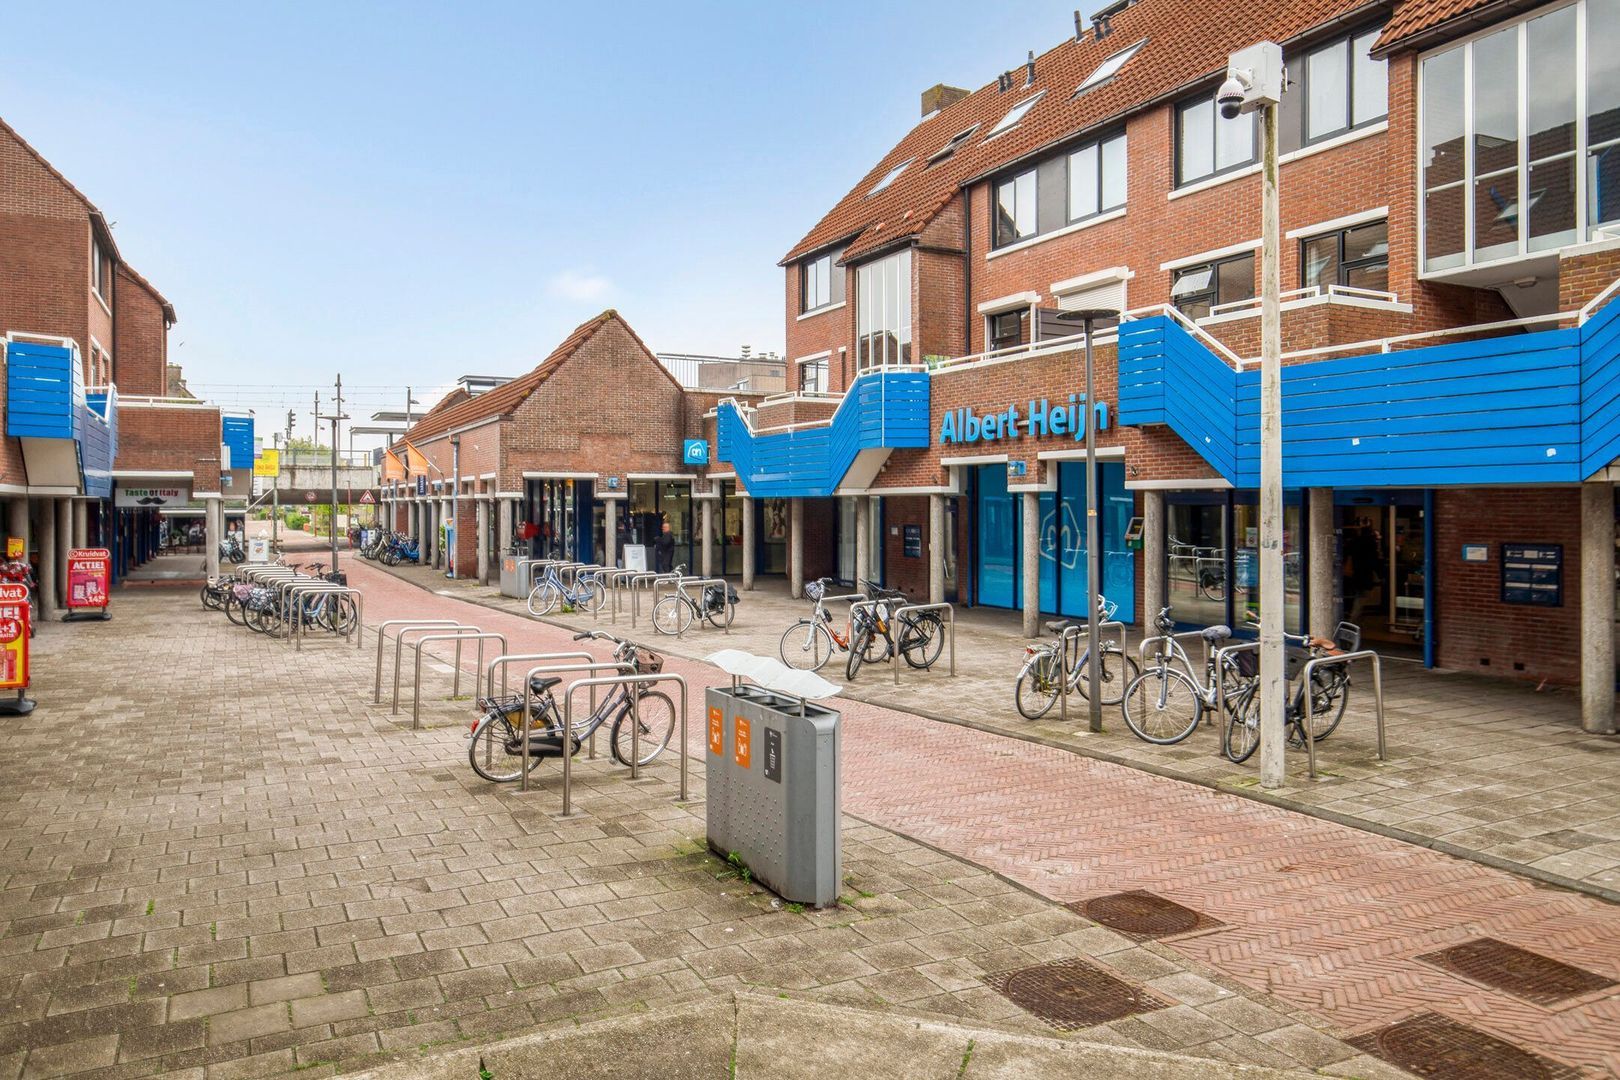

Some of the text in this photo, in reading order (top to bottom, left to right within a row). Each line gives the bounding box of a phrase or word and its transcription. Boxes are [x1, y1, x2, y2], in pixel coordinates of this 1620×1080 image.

[939, 393, 1108, 444] Albert Heijn
[125, 489, 179, 497] Taste of Italy
[73, 561, 105, 570] ACTIE!
